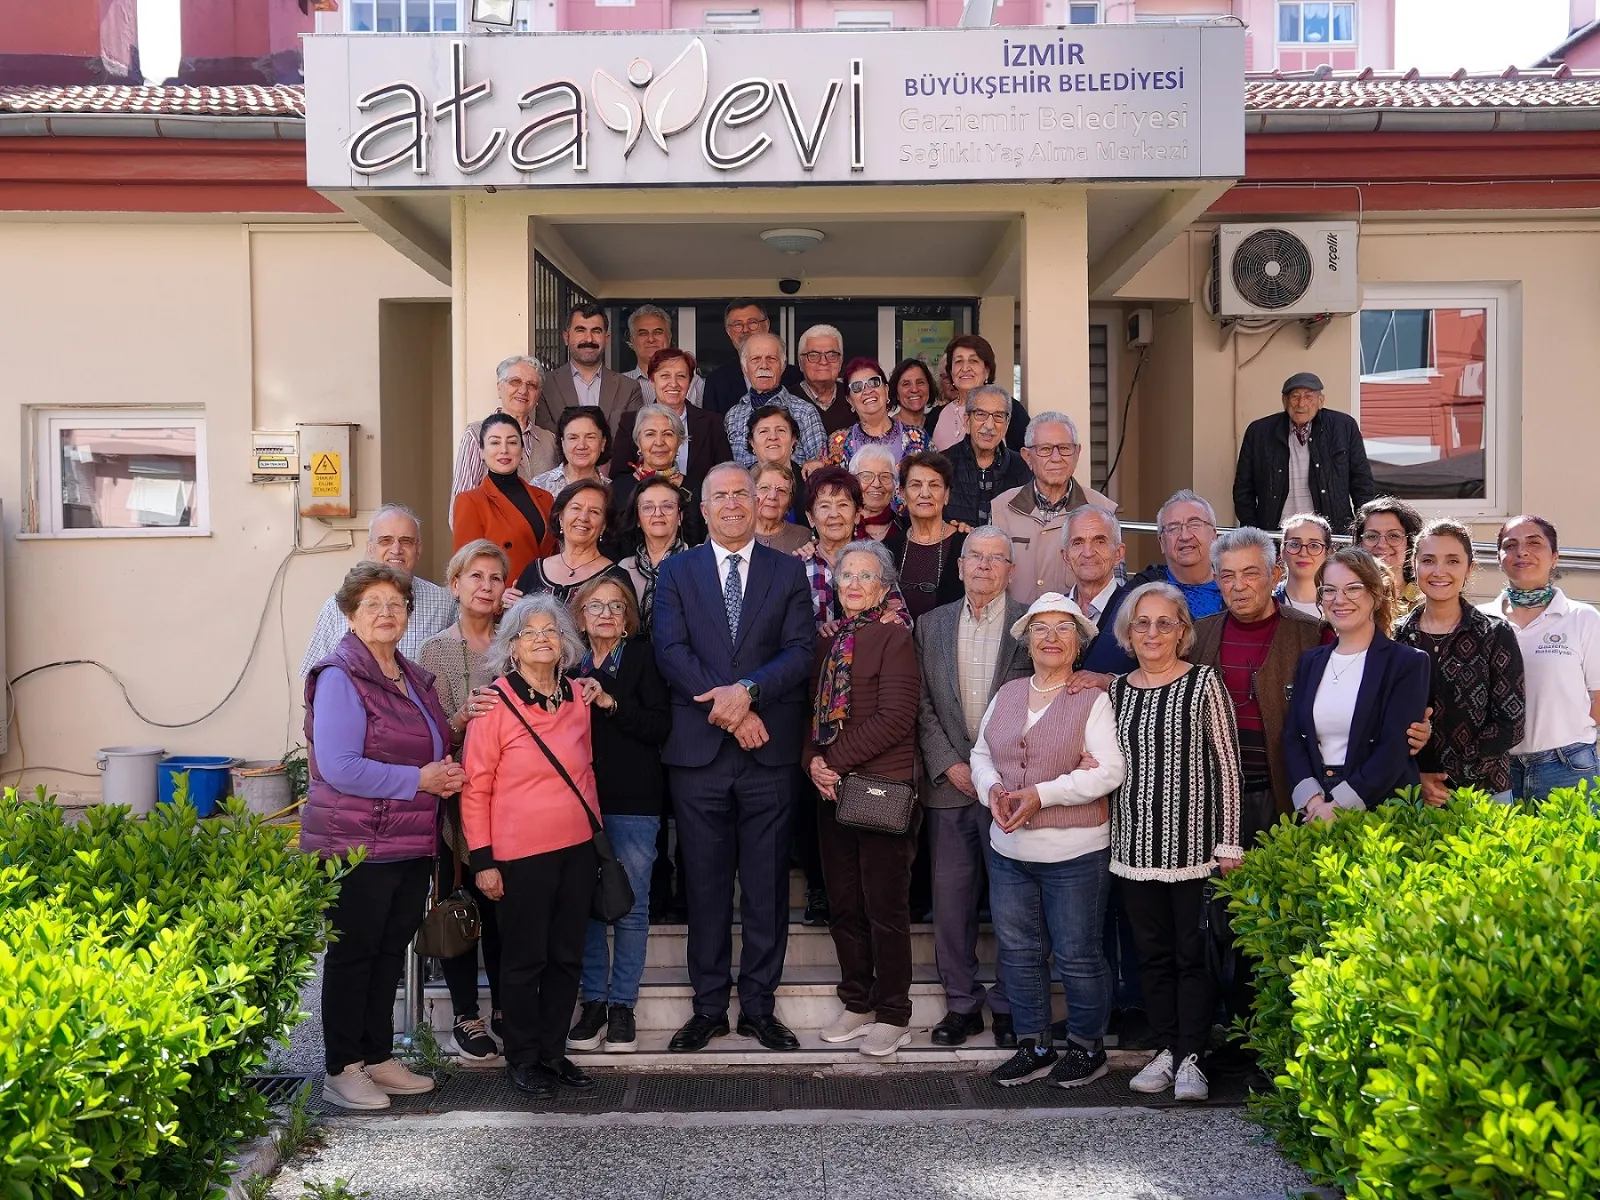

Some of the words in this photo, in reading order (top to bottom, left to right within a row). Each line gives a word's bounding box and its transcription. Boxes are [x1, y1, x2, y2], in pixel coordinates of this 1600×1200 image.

[1003, 37, 1085, 67] İZMİR
[904, 70, 1051, 99] BÜYÜKŞEHİR
[1058, 66, 1185, 93] BELEDİYESİ
[349, 39, 589, 176] ata
[701, 57, 865, 173] evi
[899, 105, 1030, 133] Gaziemir
[1037, 102, 1188, 137] Belediyesi
[899, 142, 981, 169] Sağlıklı
[985, 143, 1024, 167] Yaş
[1029, 141, 1088, 163] Alma
[1096, 139, 1188, 161] Merkezi
[1326, 232, 1340, 272] arçelik
